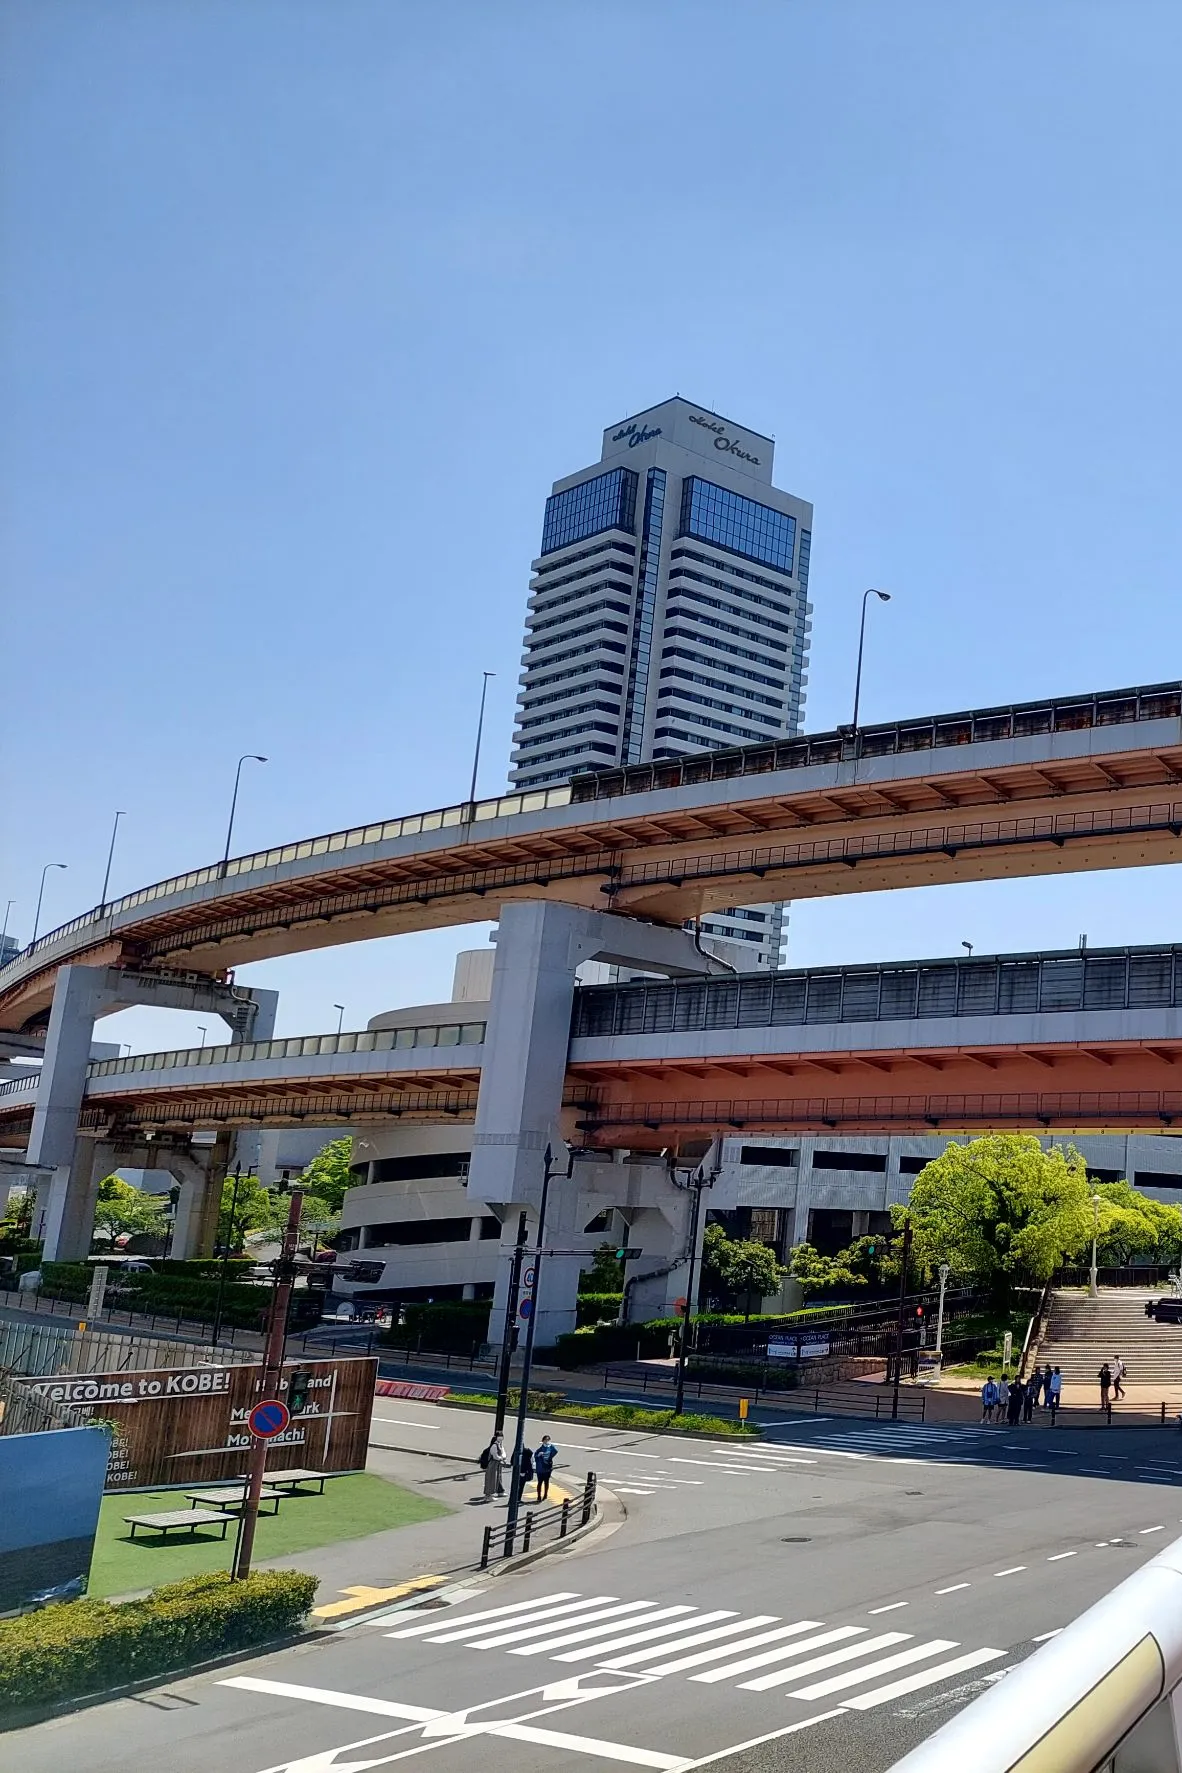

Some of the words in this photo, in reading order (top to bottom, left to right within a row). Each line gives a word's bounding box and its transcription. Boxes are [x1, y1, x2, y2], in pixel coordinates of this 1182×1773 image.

[628, 424, 662, 448] Okura
[689, 415, 725, 435] Hotel
[714, 437, 761, 466] Okura
[138, 1378, 161, 1395] to
[166, 1372, 230, 1394] KOBE!
[107, 1471, 138, 1483] KOBE!
